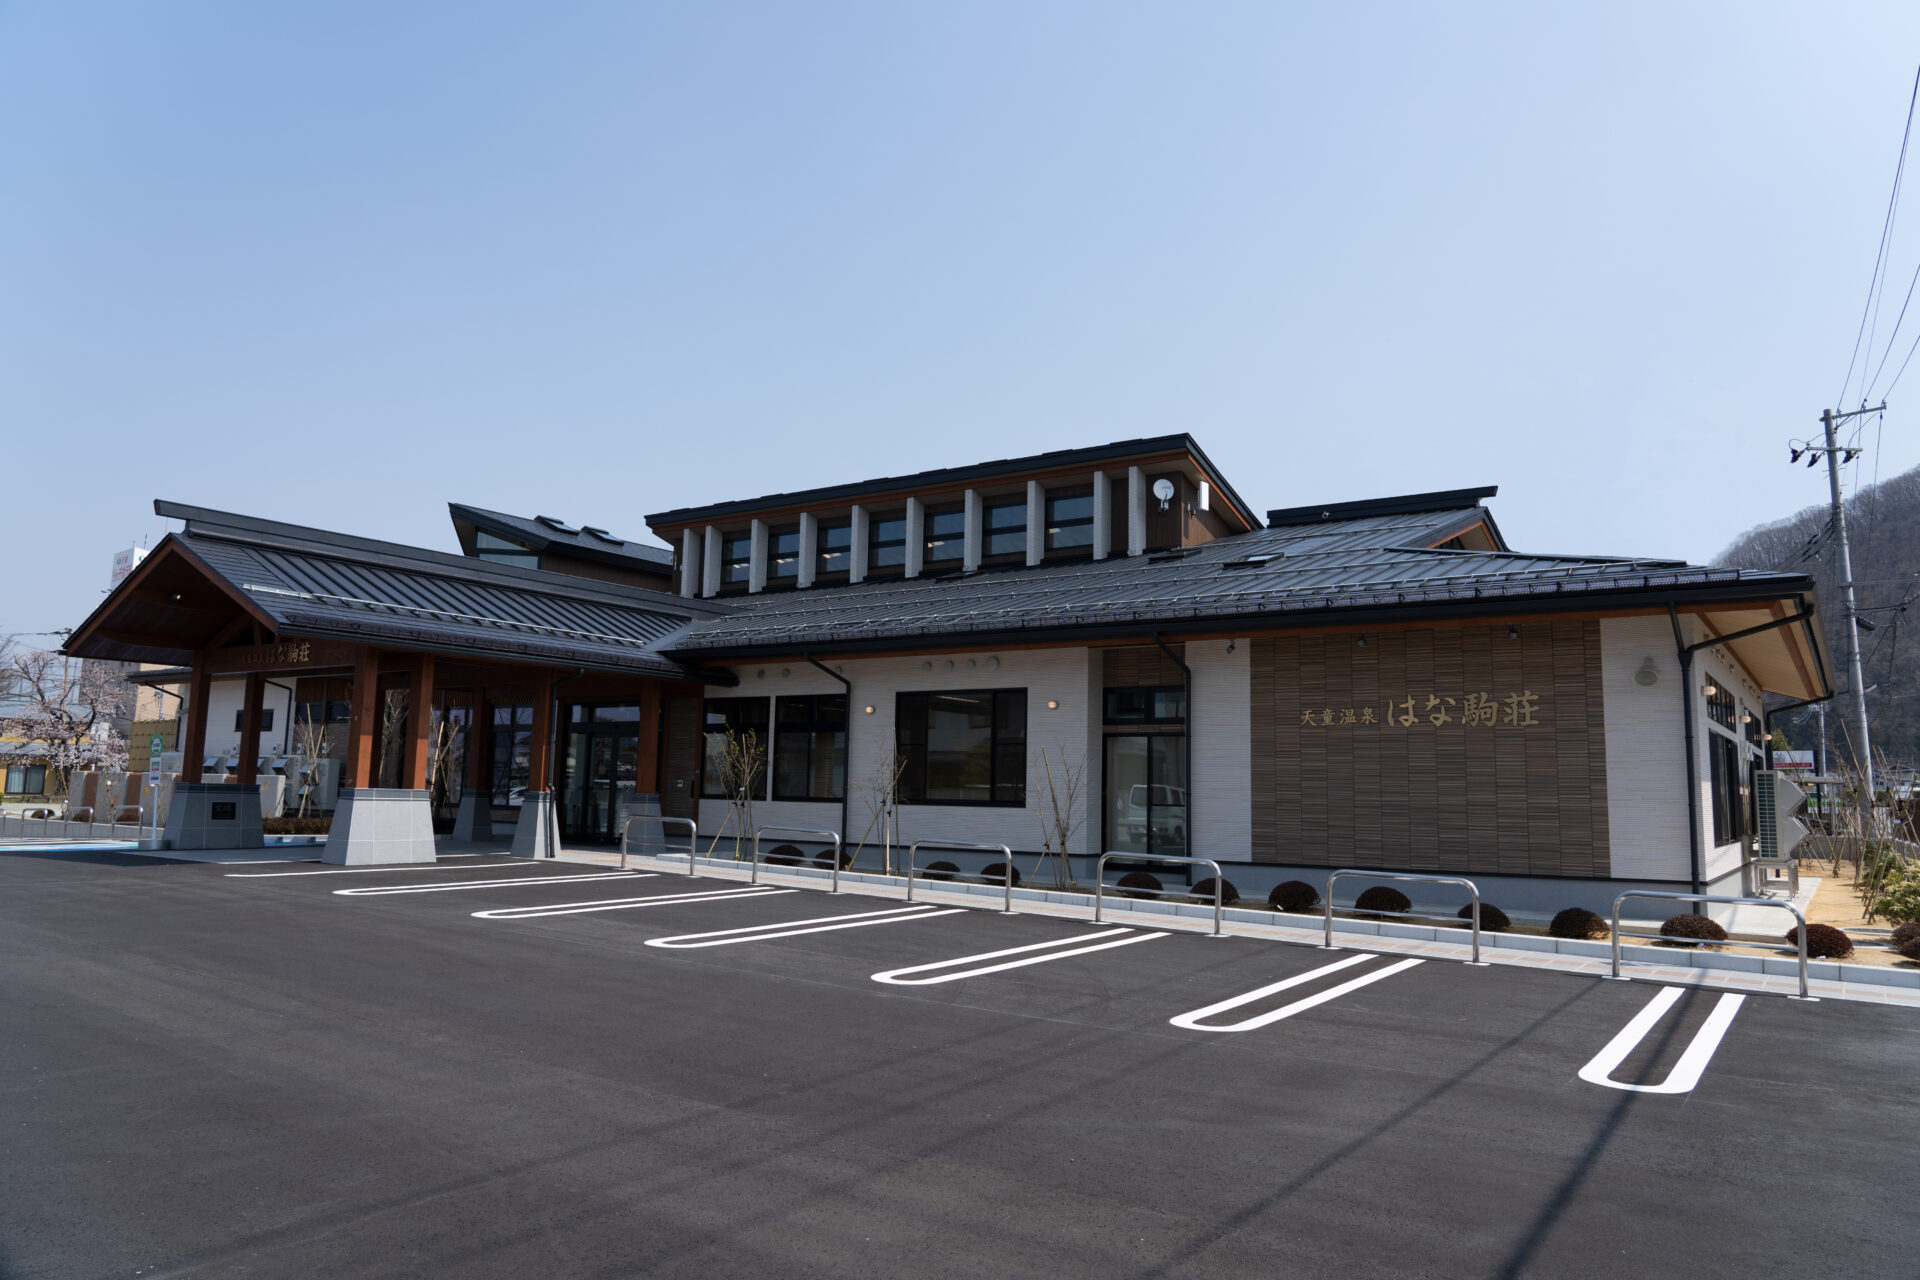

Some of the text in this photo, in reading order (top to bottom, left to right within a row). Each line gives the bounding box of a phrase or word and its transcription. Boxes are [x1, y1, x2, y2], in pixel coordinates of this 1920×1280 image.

[1301, 690, 1540, 727] 天童温泉 はな駒荘
